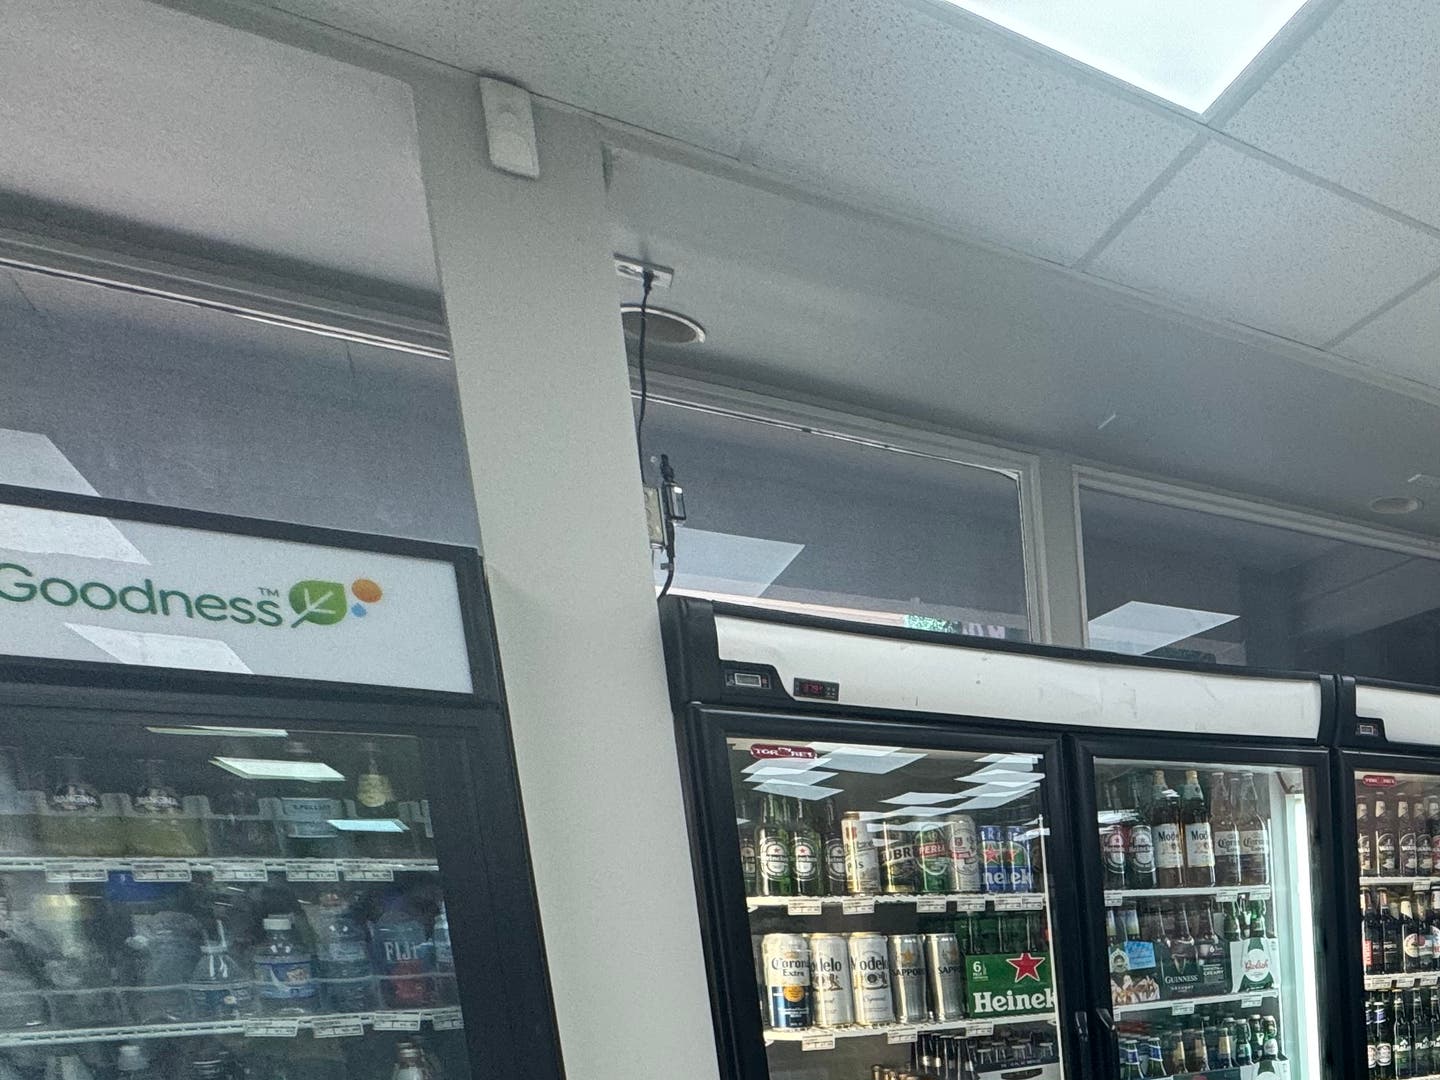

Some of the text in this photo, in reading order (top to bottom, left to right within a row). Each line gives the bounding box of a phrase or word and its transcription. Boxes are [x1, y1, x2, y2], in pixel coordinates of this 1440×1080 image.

[0, 562, 283, 628] Goodness
[972, 960, 982, 972] 6
[1164, 974, 1199, 985] GUINNESS
